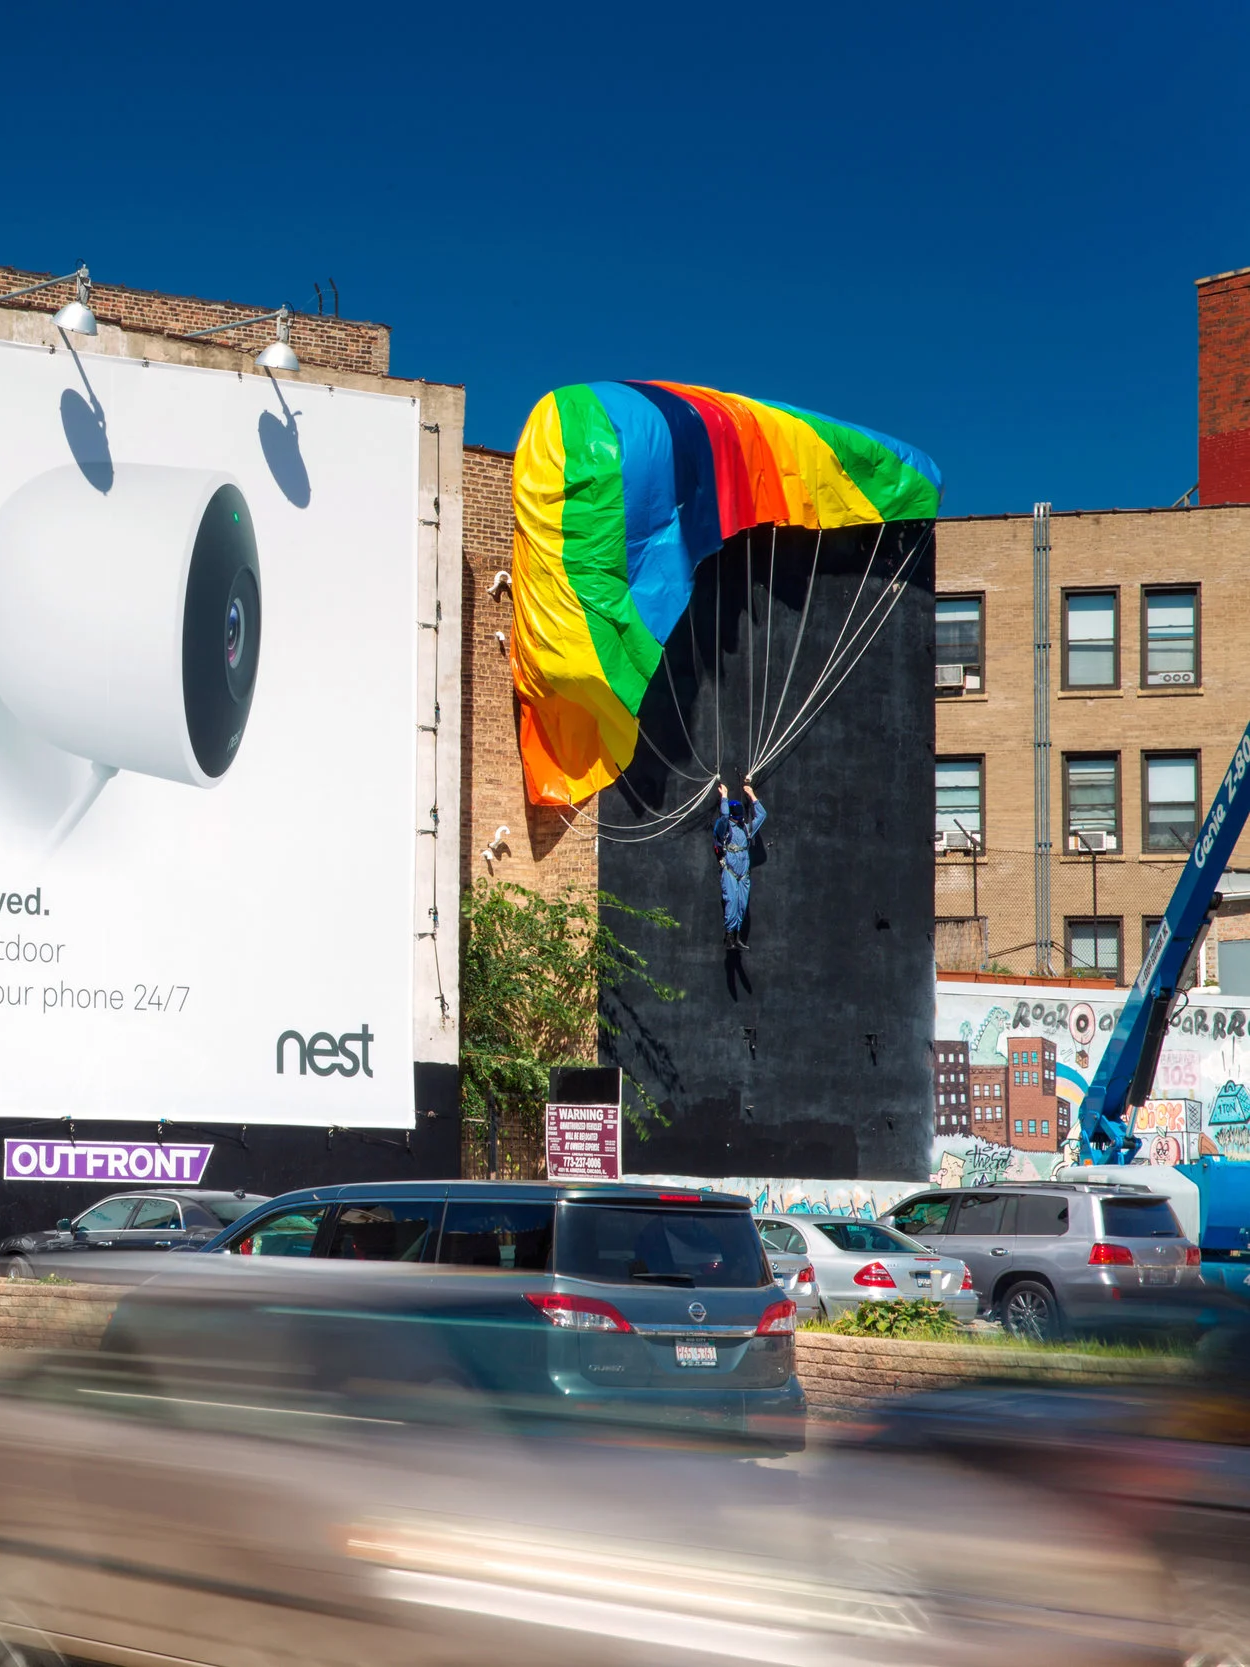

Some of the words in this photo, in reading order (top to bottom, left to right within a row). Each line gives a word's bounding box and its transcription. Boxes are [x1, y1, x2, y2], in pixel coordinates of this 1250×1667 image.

[1194, 803, 1226, 869] Genie
[43, 980, 124, 1013] phone
[133, 984, 191, 1012] 24/7
[276, 1024, 375, 1078] nest
[559, 1108, 604, 1121] WARNING
[564, 1142, 570, 1150] AT
[565, 1132, 573, 1140] WILL
[574, 1132, 579, 1140] BE
[579, 1132, 598, 1141] RELOCATED
[11, 1144, 201, 1179] OUTFRONT
[677, 1346, 692, 1360] P65
